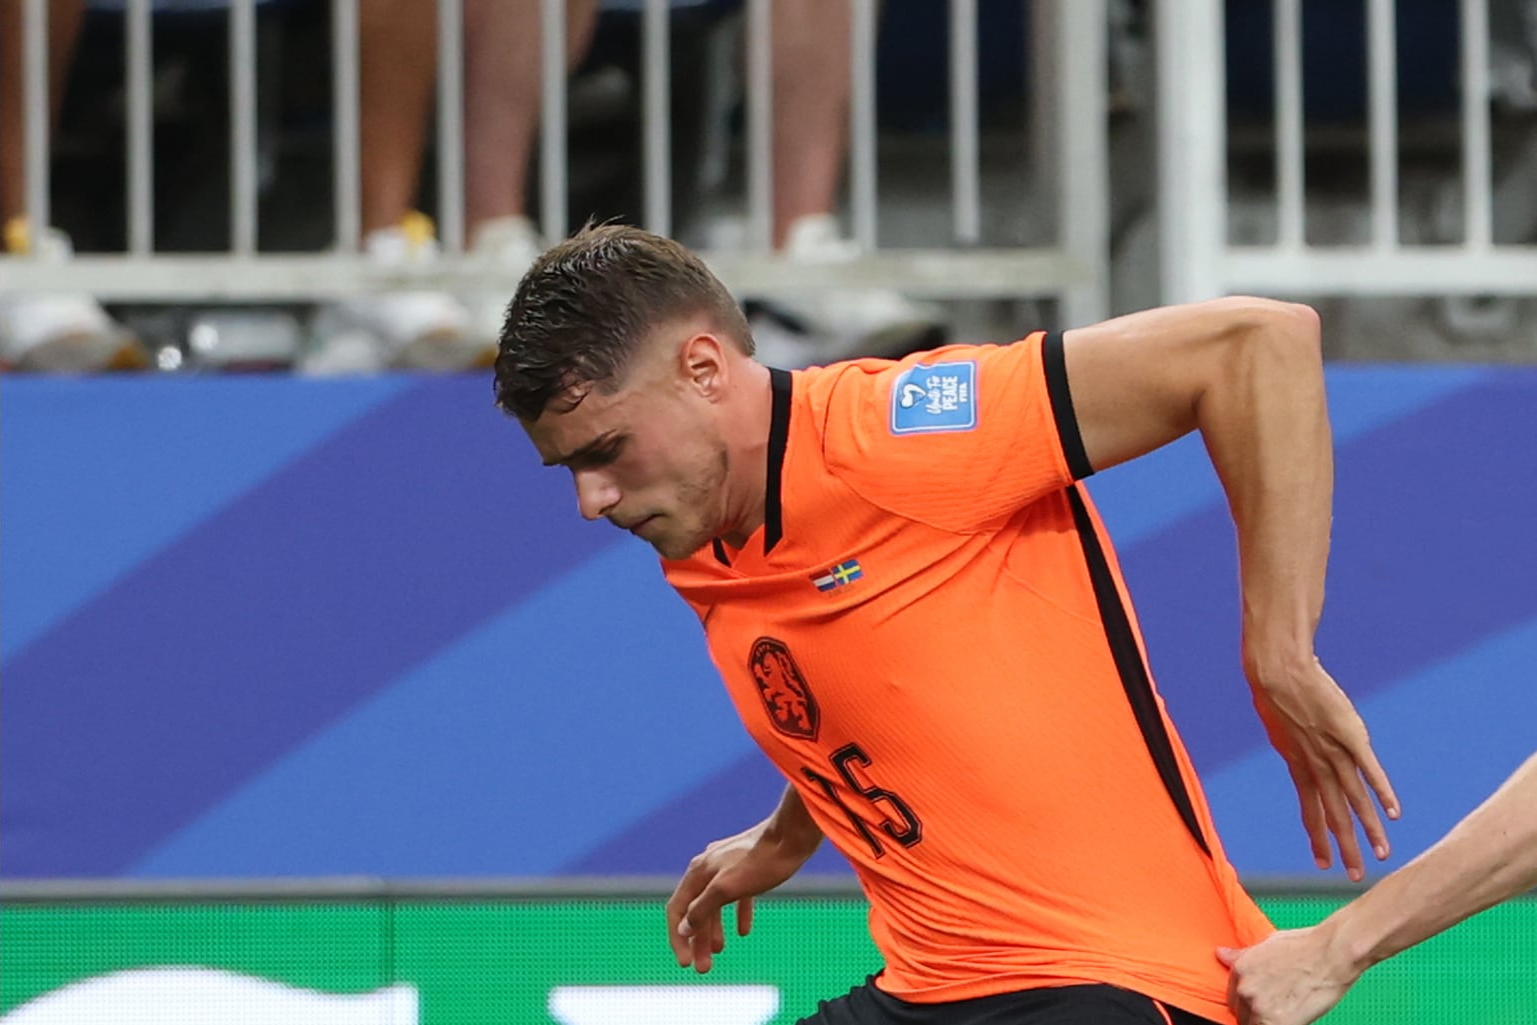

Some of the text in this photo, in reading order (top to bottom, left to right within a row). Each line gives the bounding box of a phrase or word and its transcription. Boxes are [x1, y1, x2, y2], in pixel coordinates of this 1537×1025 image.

[942, 375, 958, 411] PEACE
[959, 381, 968, 403] FIFA
[800, 742, 923, 859] 15
